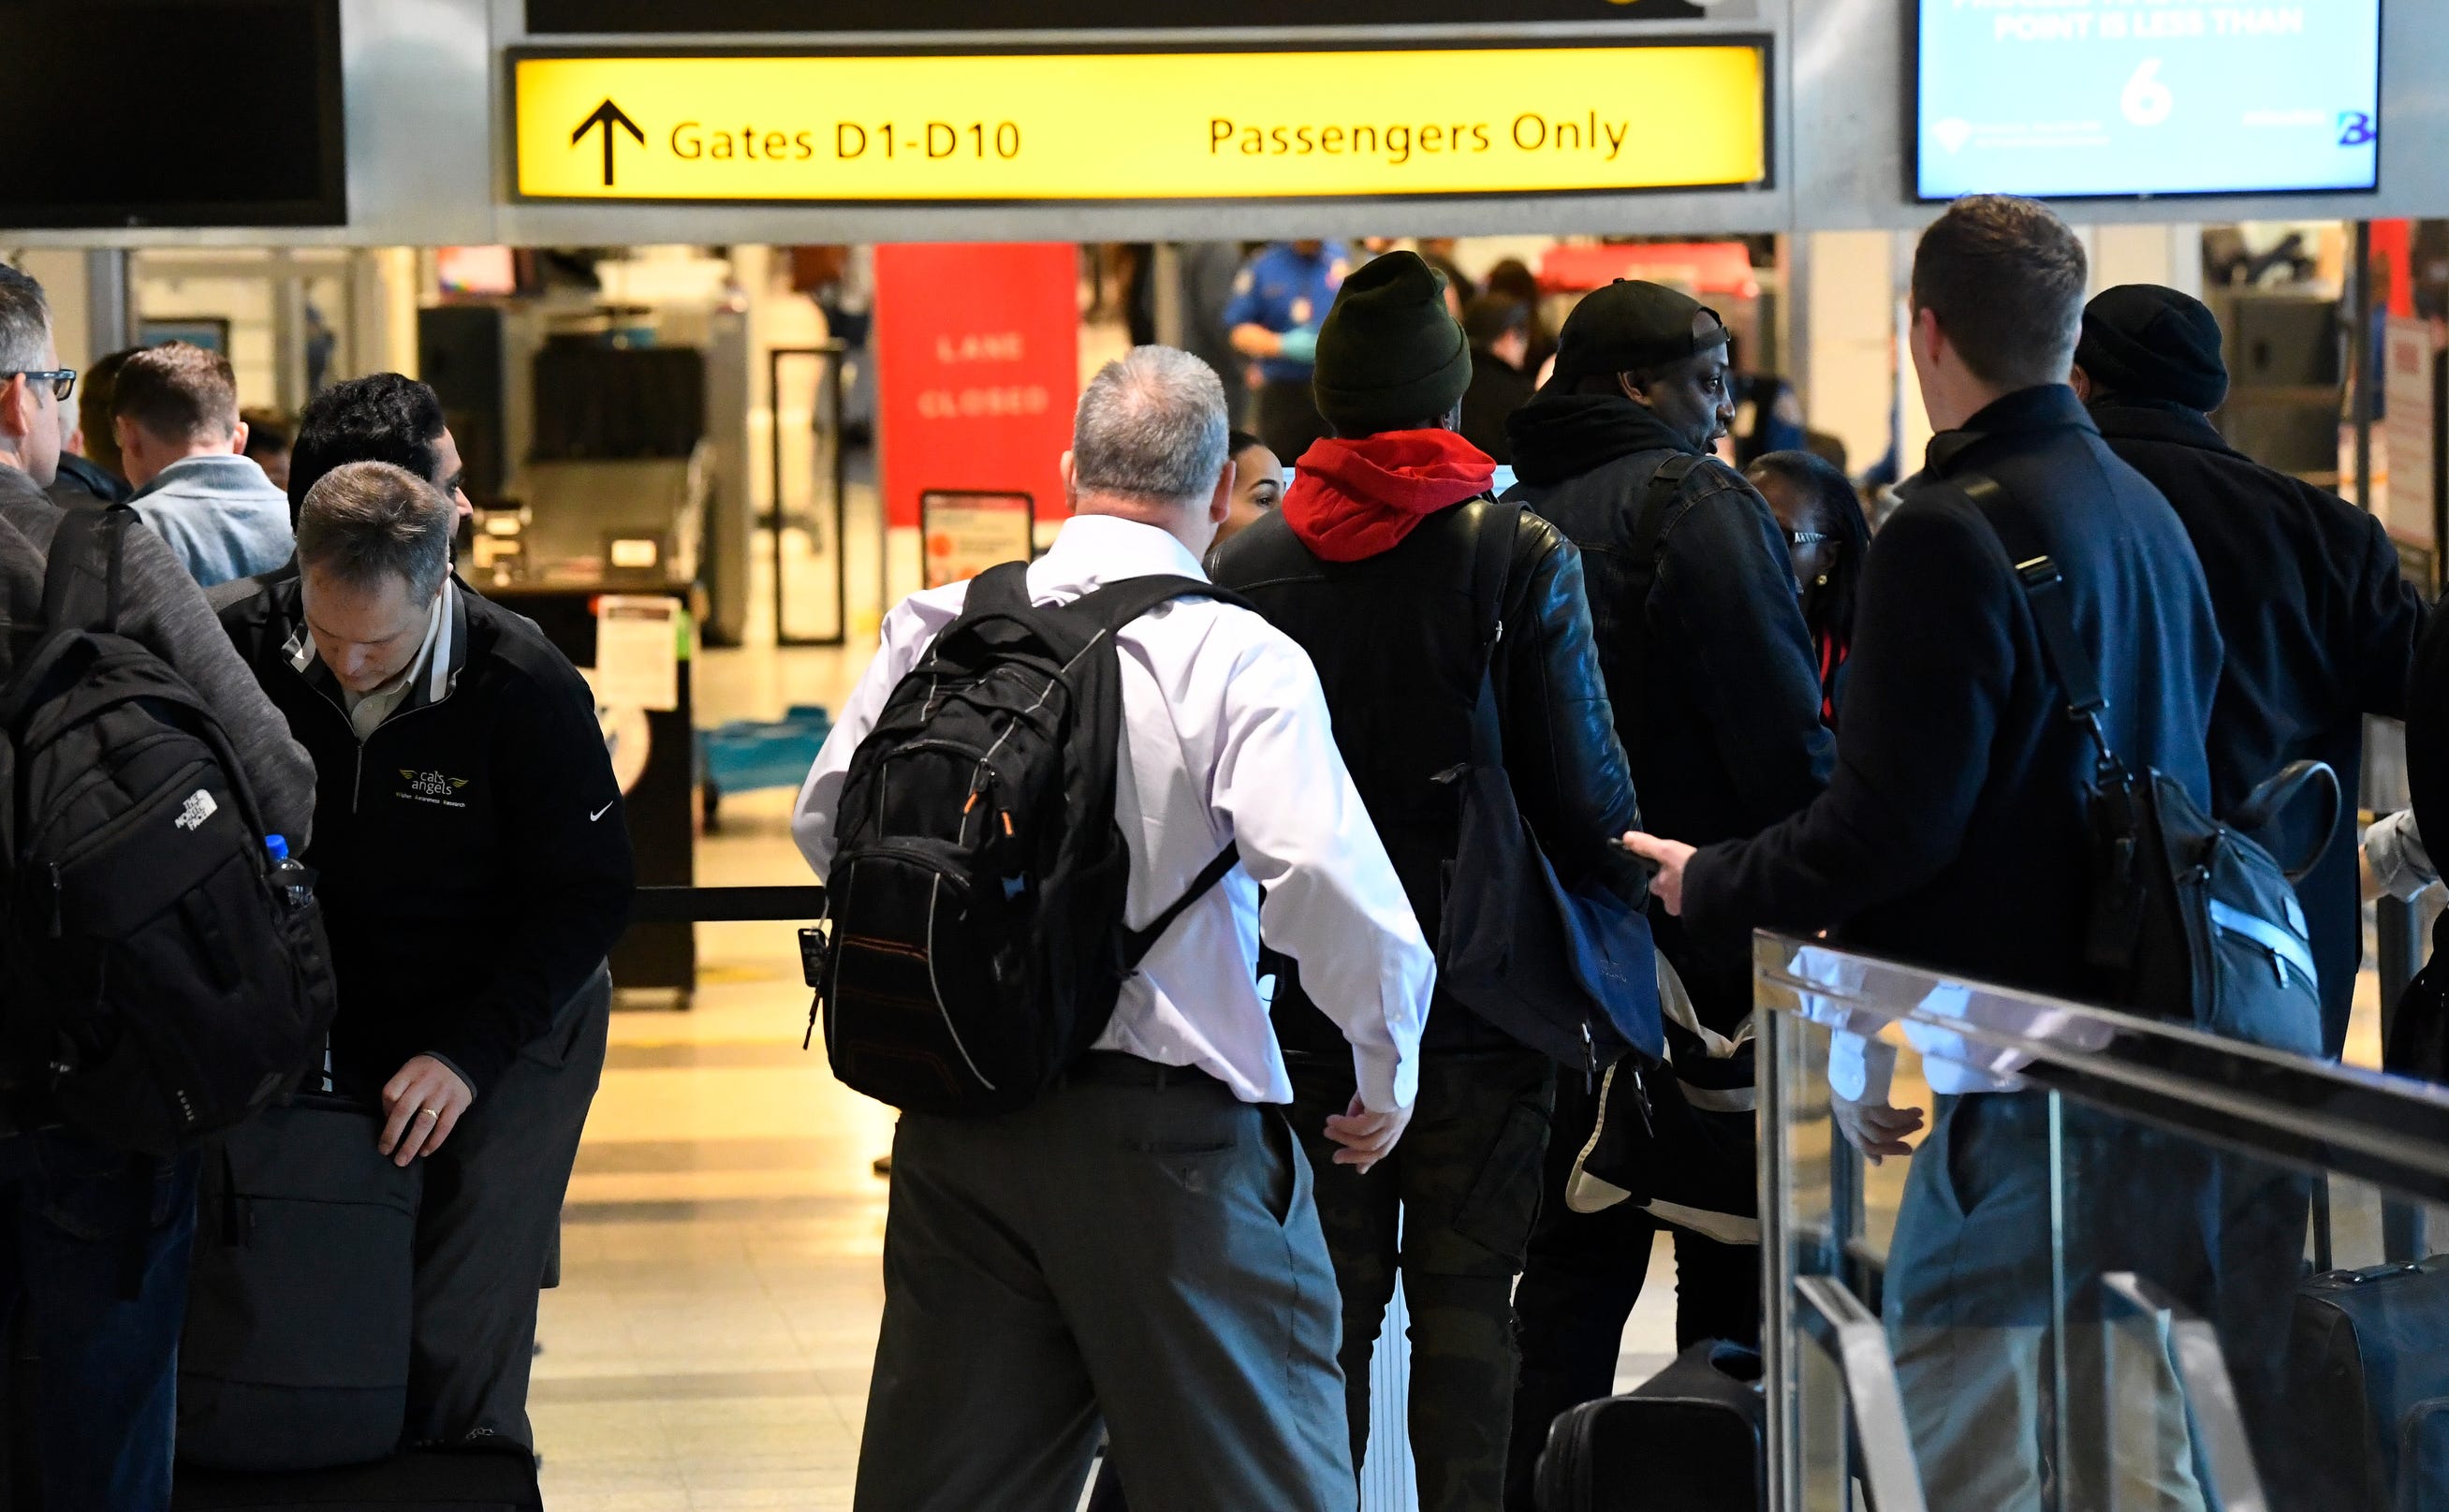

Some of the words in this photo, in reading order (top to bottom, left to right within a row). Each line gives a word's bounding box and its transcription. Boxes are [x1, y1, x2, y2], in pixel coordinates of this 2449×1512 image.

[1993, 13, 2094, 41] POINT
[2099, 10, 2128, 40] IS
[2132, 8, 2204, 37] LESS
[2209, 7, 2304, 36] THAN
[2120, 56, 2173, 125] 6
[669, 122, 813, 159] Gates
[836, 121, 1020, 159] D1-D10
[1210, 117, 1490, 164] Passengers
[1512, 110, 1628, 159] Only
[936, 330, 1025, 364] LANE
[917, 385, 1049, 419] CLOSED
[183, 793, 199, 810] THE
[412, 780, 452, 795] angels
[186, 811, 207, 830] FACE
